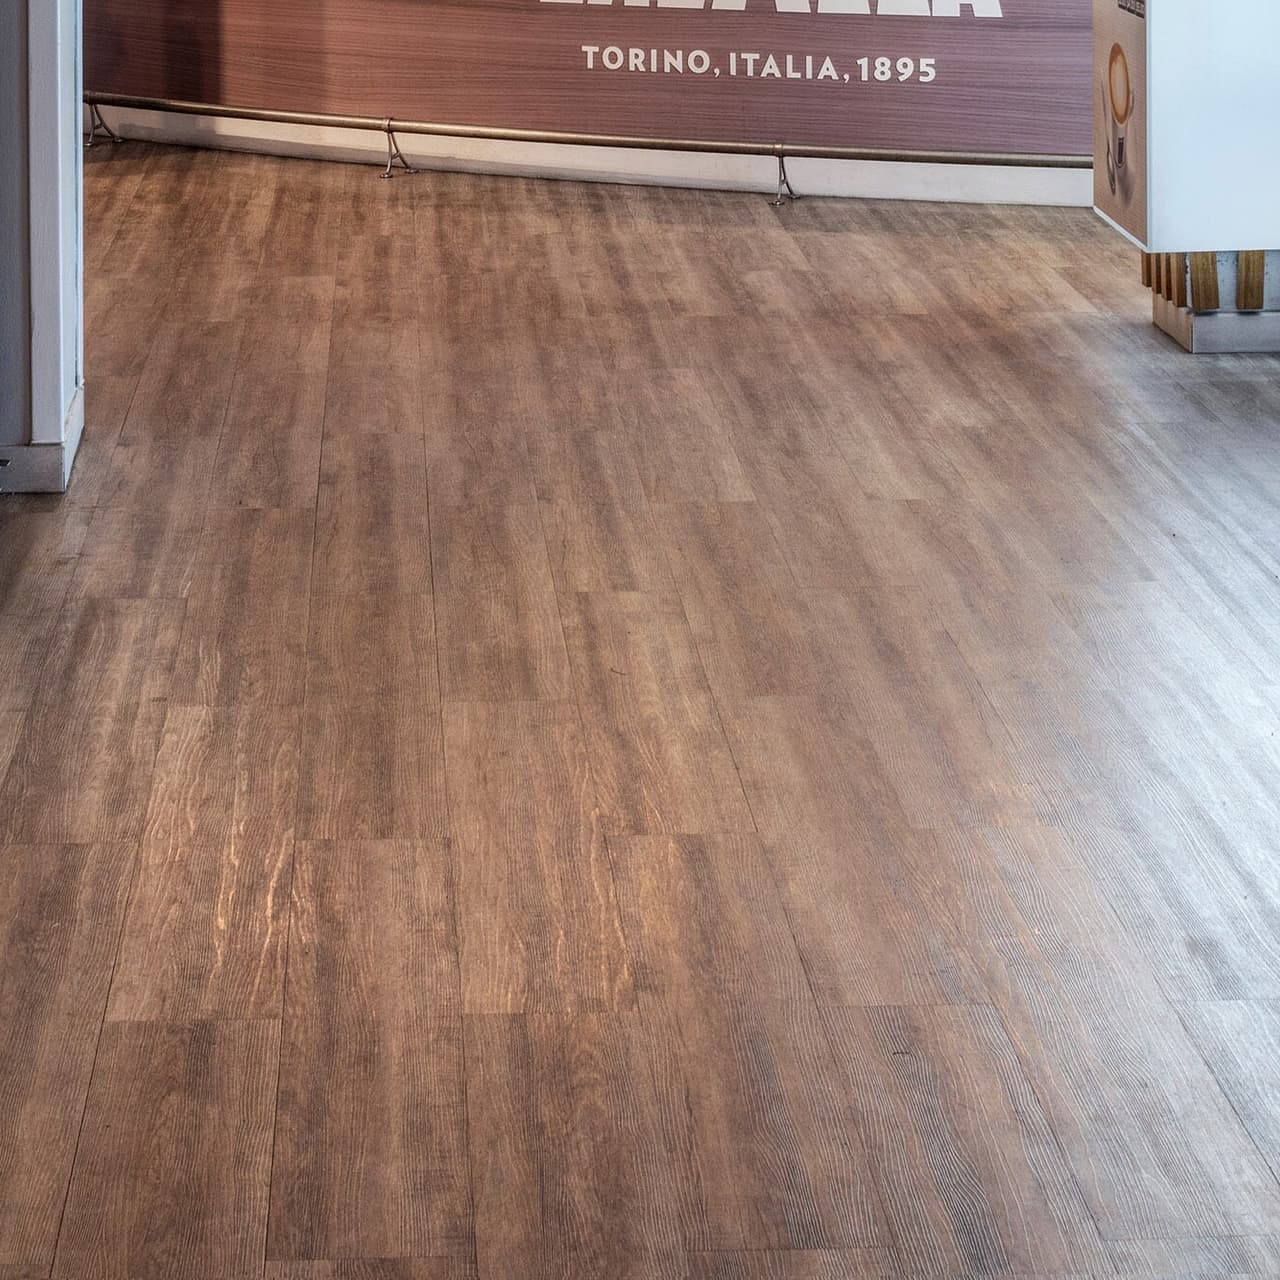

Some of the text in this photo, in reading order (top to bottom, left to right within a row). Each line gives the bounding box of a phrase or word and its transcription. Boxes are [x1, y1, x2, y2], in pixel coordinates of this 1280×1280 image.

[581, 44, 937, 84] TORINO, ITALIA, 1895
